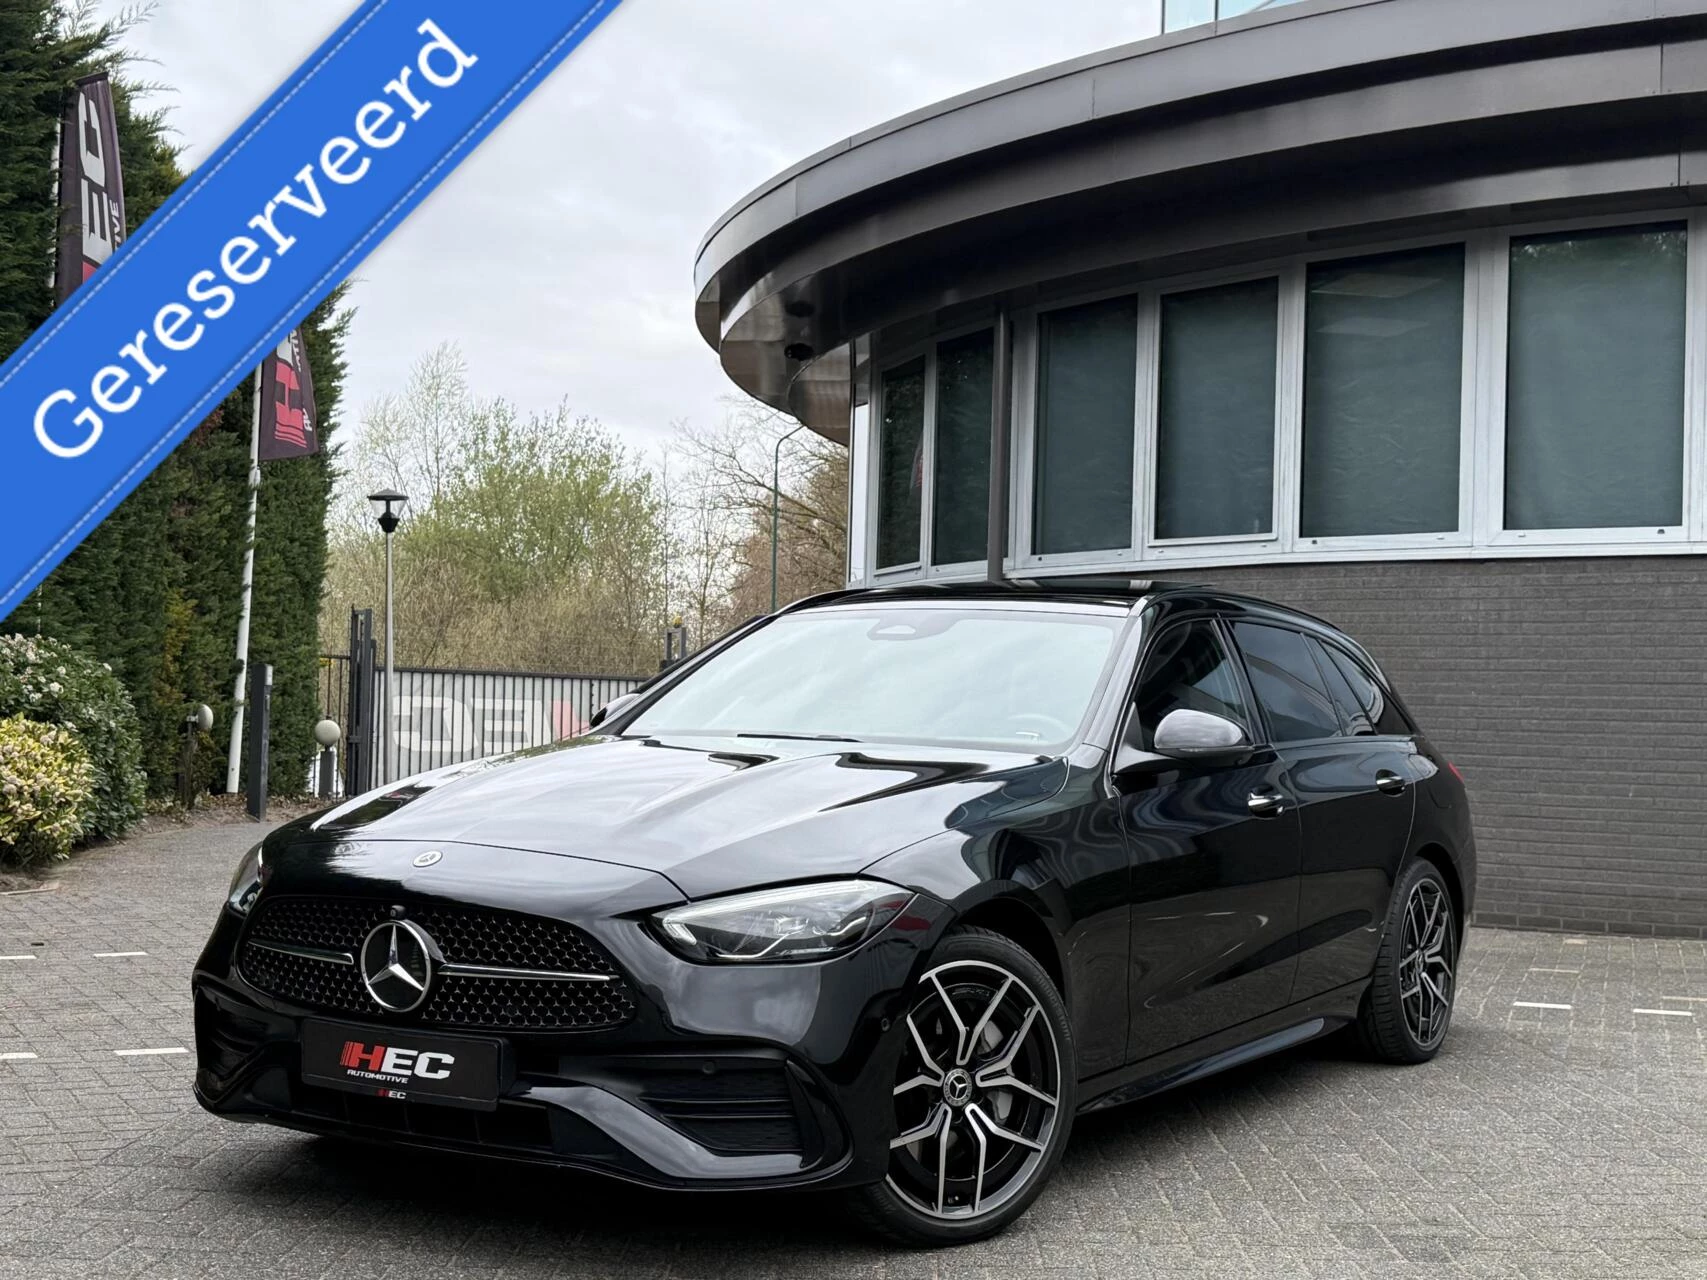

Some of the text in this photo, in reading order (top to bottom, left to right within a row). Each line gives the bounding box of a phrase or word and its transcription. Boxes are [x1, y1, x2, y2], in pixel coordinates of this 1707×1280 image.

[78, 91, 113, 283] EC
[340, 1041, 455, 1080] HEC
[346, 1069, 409, 1084] AUTOMOTIVE
[376, 1088, 406, 1099] HEC
